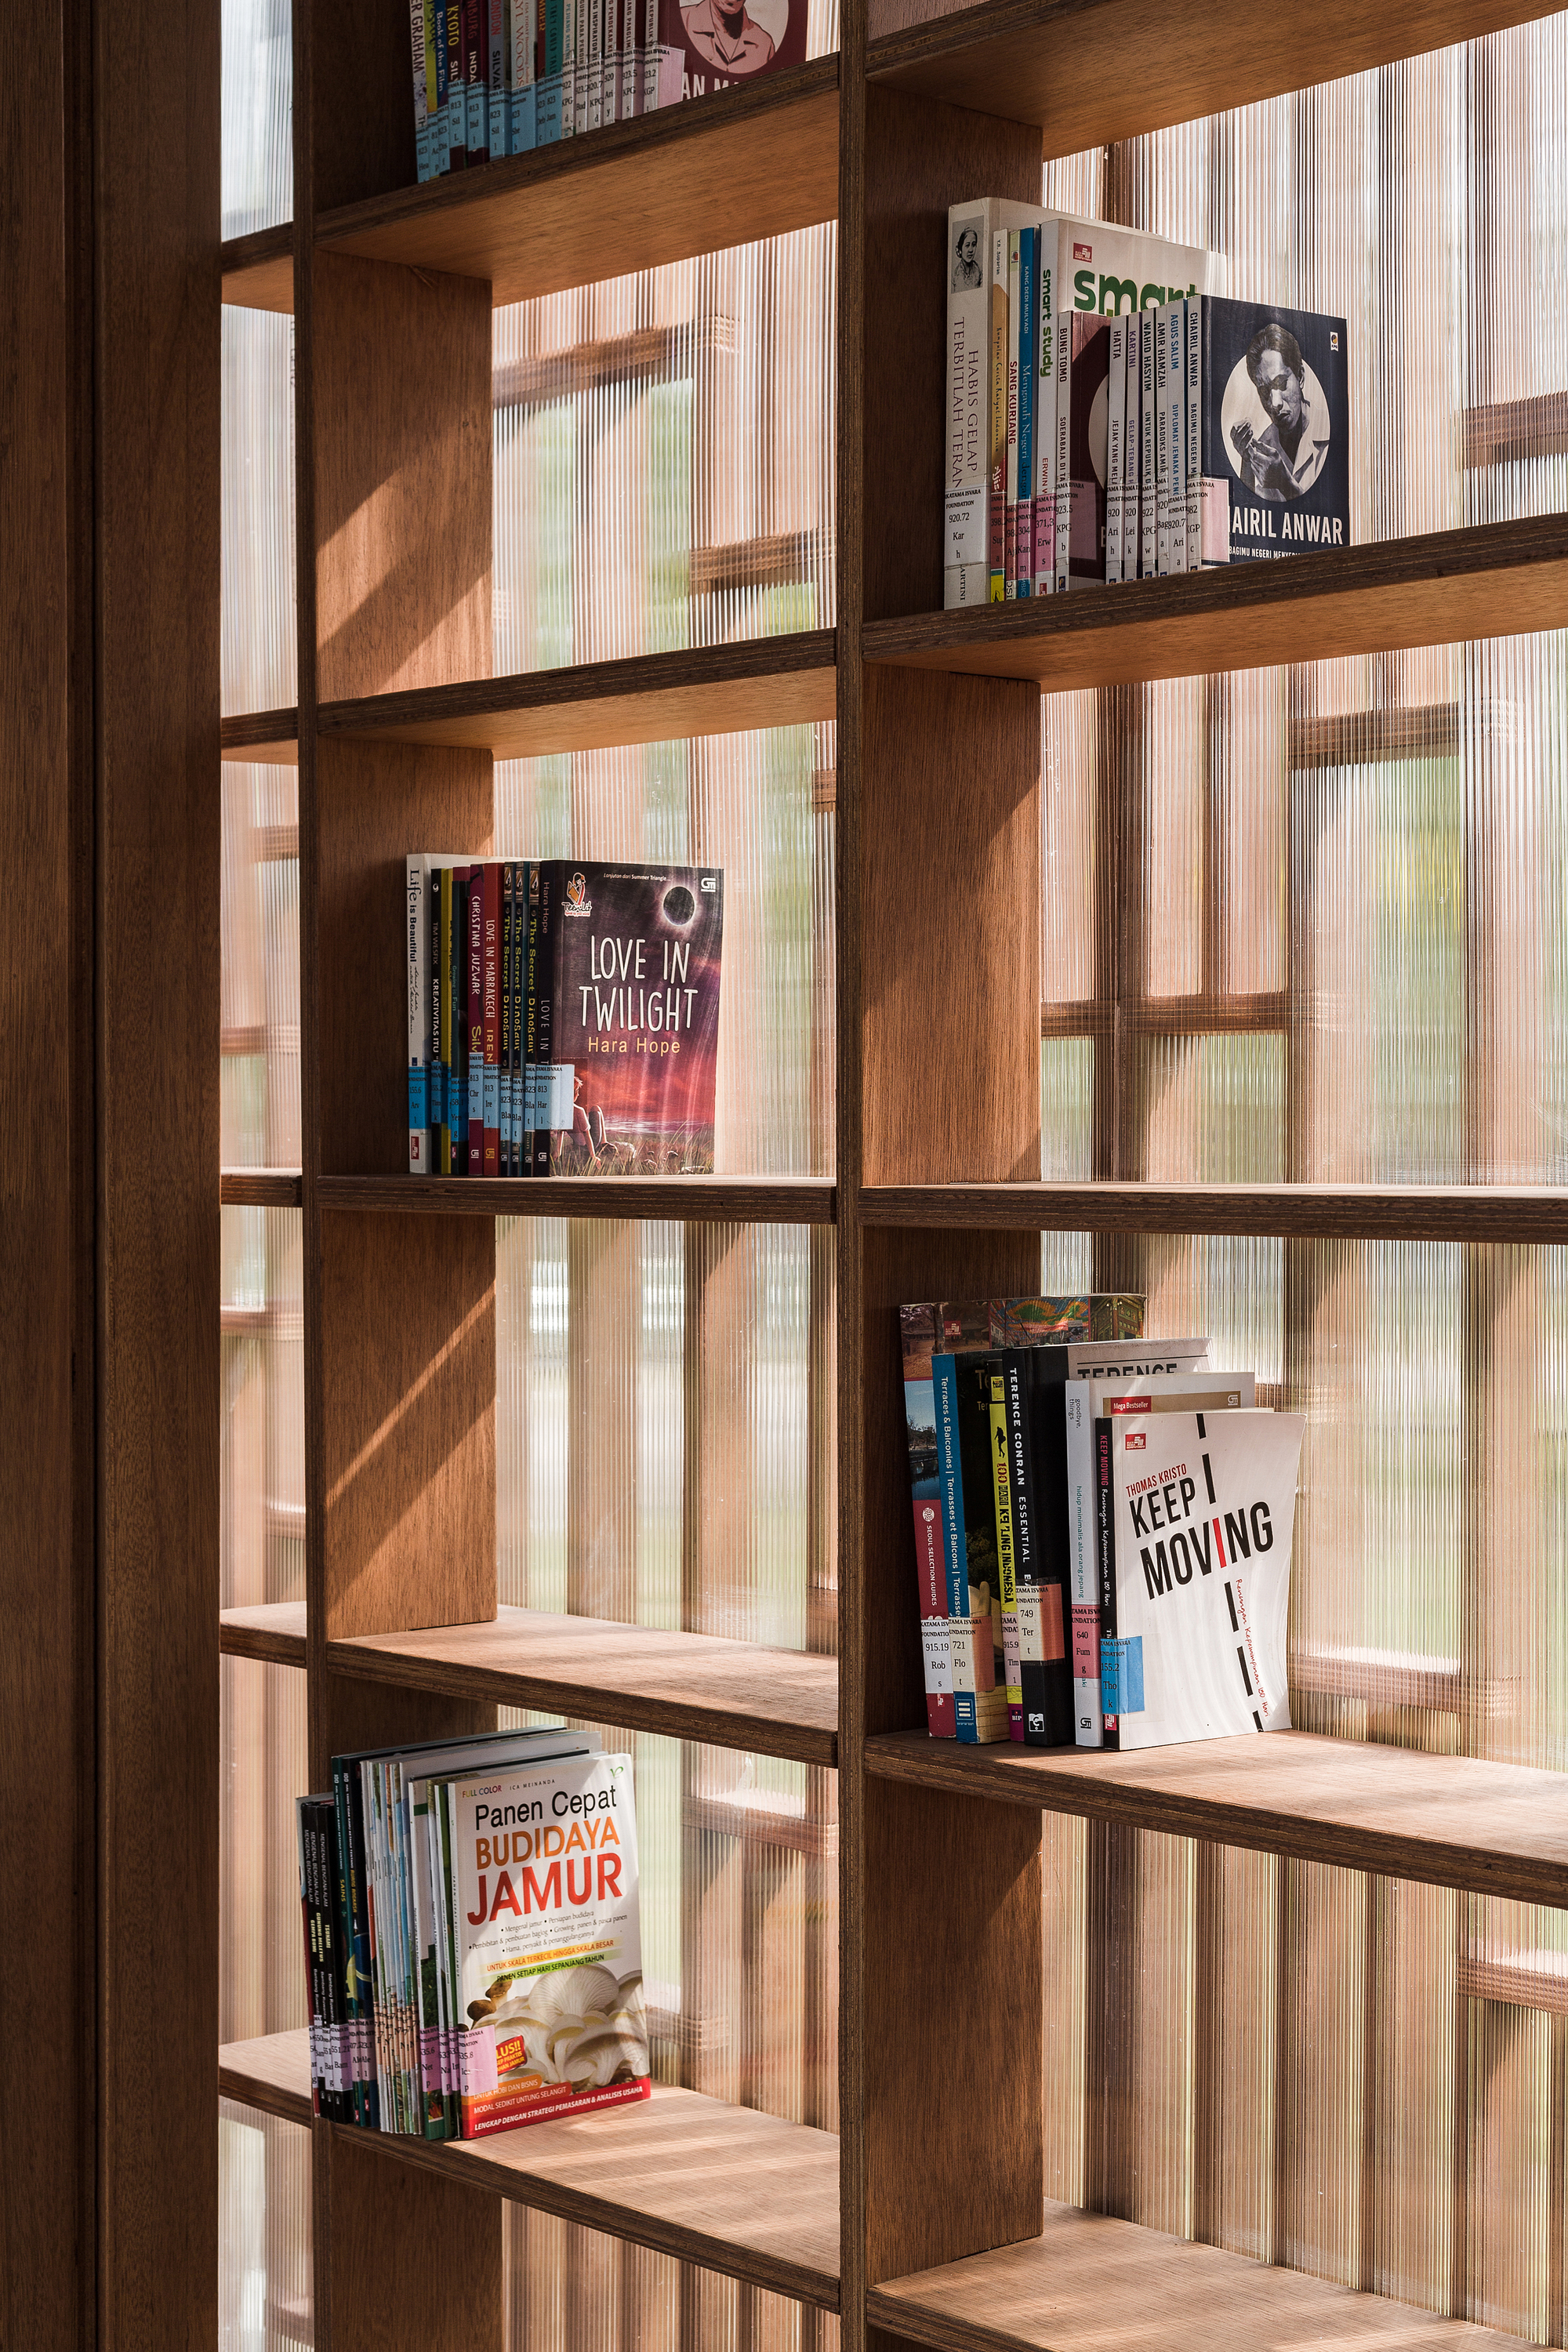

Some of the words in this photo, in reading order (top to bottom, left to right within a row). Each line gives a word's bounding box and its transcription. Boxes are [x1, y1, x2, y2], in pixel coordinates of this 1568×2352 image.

[448, 5, 459, 45] KYOTO
[412, 16, 425, 74] GRAHAM
[437, 38, 444, 49] of
[516, 26, 524, 87] WOODS
[1043, 269, 1051, 321] smart
[1113, 330, 1122, 360] HATTA
[1189, 311, 1198, 351] CHAIRIL
[1040, 326, 1053, 377] study
[1158, 349, 1167, 388] HAMZAH
[1171, 340, 1179, 369] SALIM
[953, 316, 964, 430] TERBITLAH
[969, 350, 979, 407] HABIS
[1189, 354, 1198, 387] ANWAR
[1022, 365, 1031, 421] Mengayuh
[967, 412, 978, 472] GELAP
[1022, 424, 1031, 459] Negeri
[949, 512, 970, 524] 920.72
[1108, 508, 1120, 517] 920
[1125, 507, 1136, 517] 920
[1232, 506, 1277, 538] AIRIL
[1282, 512, 1344, 545] ANWAR
[953, 531, 964, 541] Kar
[1252, 548, 1272, 558] NEGERI
[407, 869, 423, 902] Life
[409, 905, 416, 914] is
[408, 917, 417, 964] Beautiful
[486, 920, 495, 942] LOVE
[472, 953, 481, 995] JUZWAR
[591, 935, 647, 981] LOVE
[663, 940, 690, 984] IN
[486, 962, 495, 1018] MARRAKECH
[541, 1000, 550, 1028] LOVE
[579, 985, 698, 1032] TWILIGHT
[588, 1036, 627, 1052] Hara
[637, 1037, 681, 1058] Hope
[941, 1377, 950, 1415] Terraces
[1010, 1368, 1022, 1427] TERENCE
[1114, 1403, 1126, 1411] Mega
[1127, 1401, 1149, 1410] Bestseller
[944, 1425, 954, 1470] Balconies
[1014, 1433, 1025, 1485] CONRAN
[1101, 1456, 1109, 1486] MOVING
[1126, 1475, 1158, 1498] THOMAS
[1158, 1463, 1188, 1485] KRISTO
[947, 1477, 956, 1521] Terrasses
[1098, 1490, 1109, 1528] Renungan
[1129, 1477, 1196, 1539] KEEP
[1019, 1496, 1031, 1563] ESSENTIAL
[950, 1534, 959, 1570] Balcons
[1140, 1501, 1275, 1601] MOVING
[1020, 1609, 1034, 1618] 749
[925, 1642, 949, 1653] 915.19
[953, 1641, 965, 1650] 721
[1022, 1628, 1034, 1637] Ter
[1076, 1631, 1089, 1639] 640
[1236, 1579, 1247, 1625] Renungan
[1245, 1627, 1260, 1686] Kepemimpinan
[931, 1661, 946, 1670] Rob
[953, 1658, 966, 1668] Flo
[1007, 1658, 1019, 1667] Tim
[1076, 1648, 1091, 1657] Fum
[1102, 1662, 1120, 1671] 155.2
[1103, 1681, 1117, 1690] Tho
[463, 1788, 477, 1798] FULL
[478, 1784, 502, 1796] COLOR
[523, 1778, 556, 1789] MEINANDA
[476, 1800, 543, 1831] Panen
[552, 1785, 617, 1820] Cepat
[476, 1816, 622, 1871] BUDIDAYA
[467, 1853, 624, 1926] JAMUR
[487, 1963, 506, 1972] UNTUK
[507, 1959, 526, 1968] SKALA
[527, 1952, 553, 1965] TERKECIL
[553, 1948, 576, 1958] HINGGA
[576, 1944, 595, 1953] SKALA
[596, 1940, 614, 1949] BESAR
[517, 1969, 536, 1979] SETIAP
[536, 1965, 551, 1974] HARI
[551, 1958, 585, 1971] SEPANJANG
[585, 1954, 604, 1965] TAHUN
[474, 2105, 495, 2114] MODAL
[495, 2098, 517, 2111] SEDIKIT
[517, 2093, 540, 2105] UNTUNG
[540, 2086, 568, 2100] SELANGIT
[493, 2086, 507, 2097] HOBI
[508, 2083, 521, 2092] DAN
[521, 2078, 539, 2090] BISNIS
[474, 2118, 502, 2131] LENGKAP
[502, 2113, 528, 2125] DENGAN
[527, 2107, 555, 2119] STRATEGI
[555, 2099, 591, 2112] PEMASARAN
[597, 2091, 622, 2102] ANALISIS
[622, 2085, 644, 2097] USAHA
